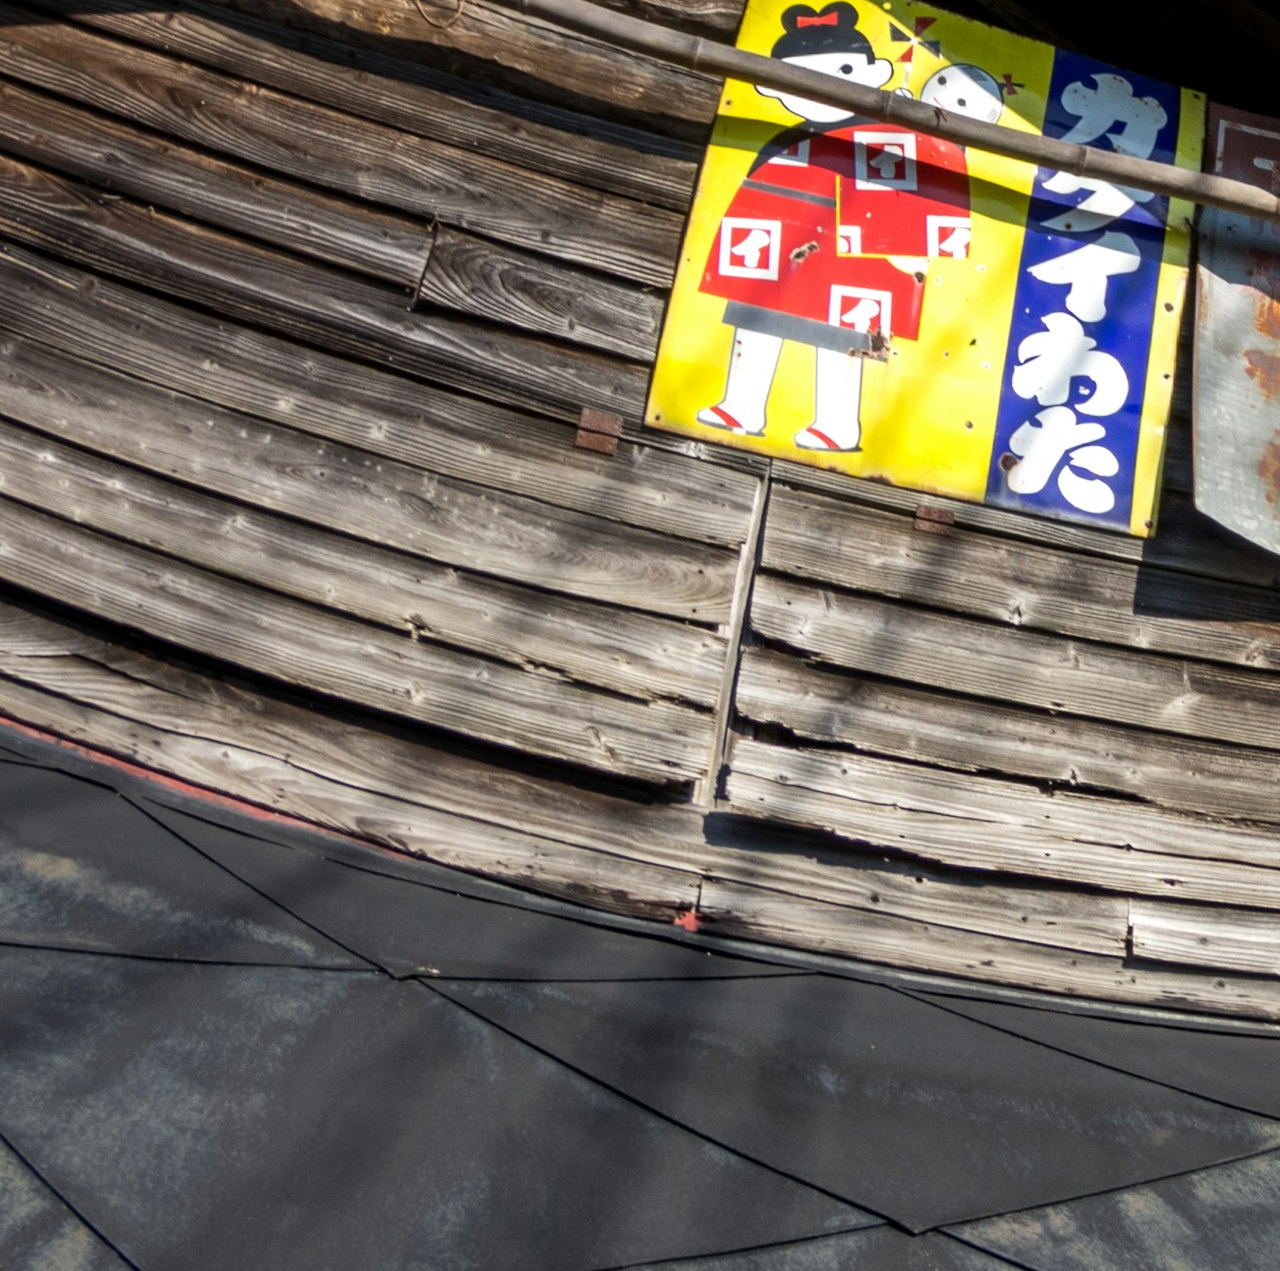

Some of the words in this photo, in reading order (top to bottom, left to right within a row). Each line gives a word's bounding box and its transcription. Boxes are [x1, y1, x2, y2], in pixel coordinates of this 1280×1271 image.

[1009, 73, 1168, 513] カクイわた
